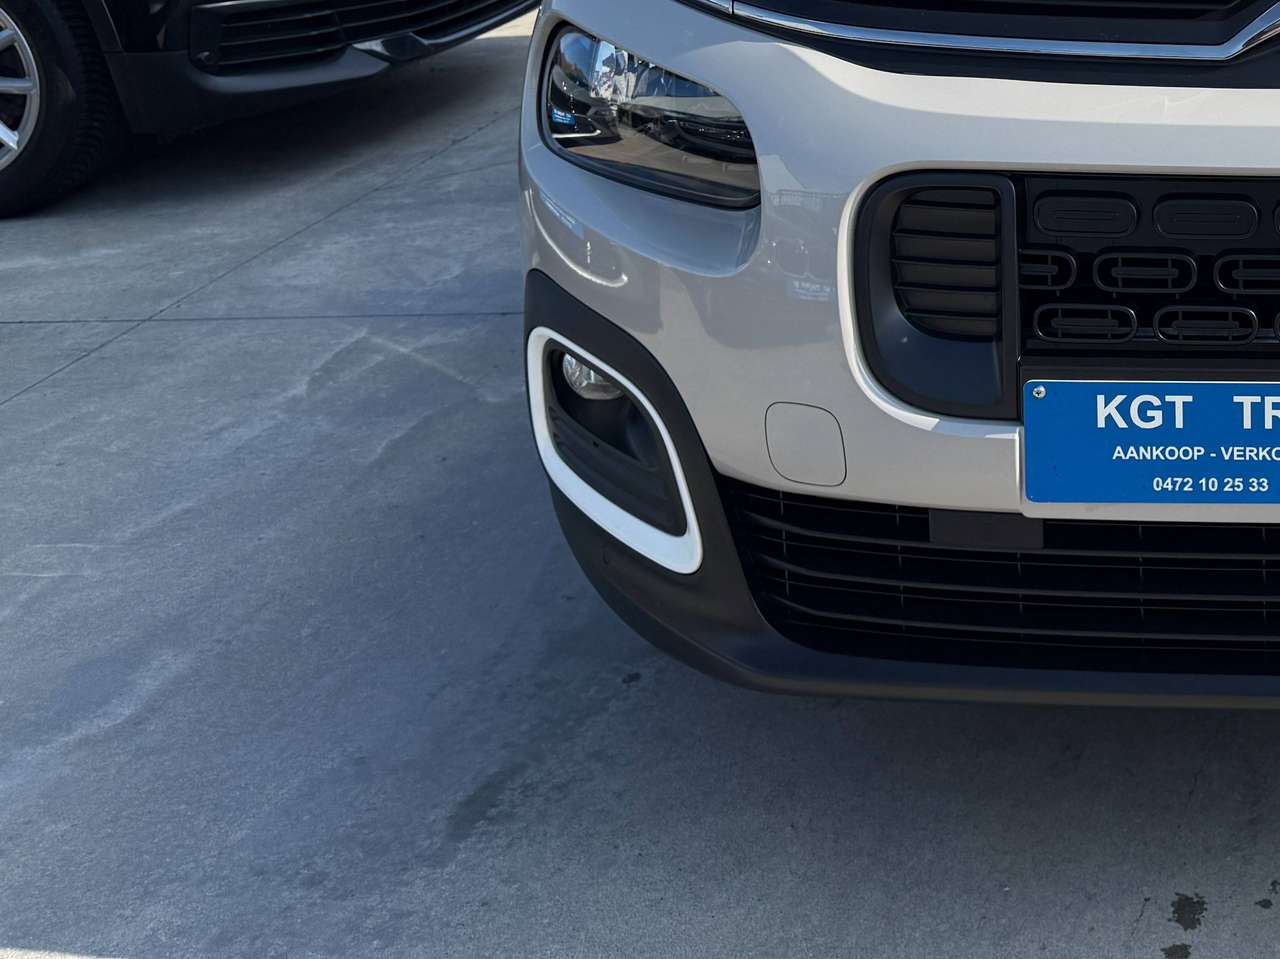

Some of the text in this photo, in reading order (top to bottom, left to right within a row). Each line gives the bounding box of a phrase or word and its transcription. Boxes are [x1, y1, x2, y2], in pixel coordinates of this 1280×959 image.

[1096, 394, 1193, 429] KGT
[1112, 446, 1205, 461] AANKOOP
[1153, 477, 1193, 492] 0472
[1199, 477, 1218, 492] 10
[1223, 477, 1244, 492] 25
[1248, 478, 1269, 492] 33
